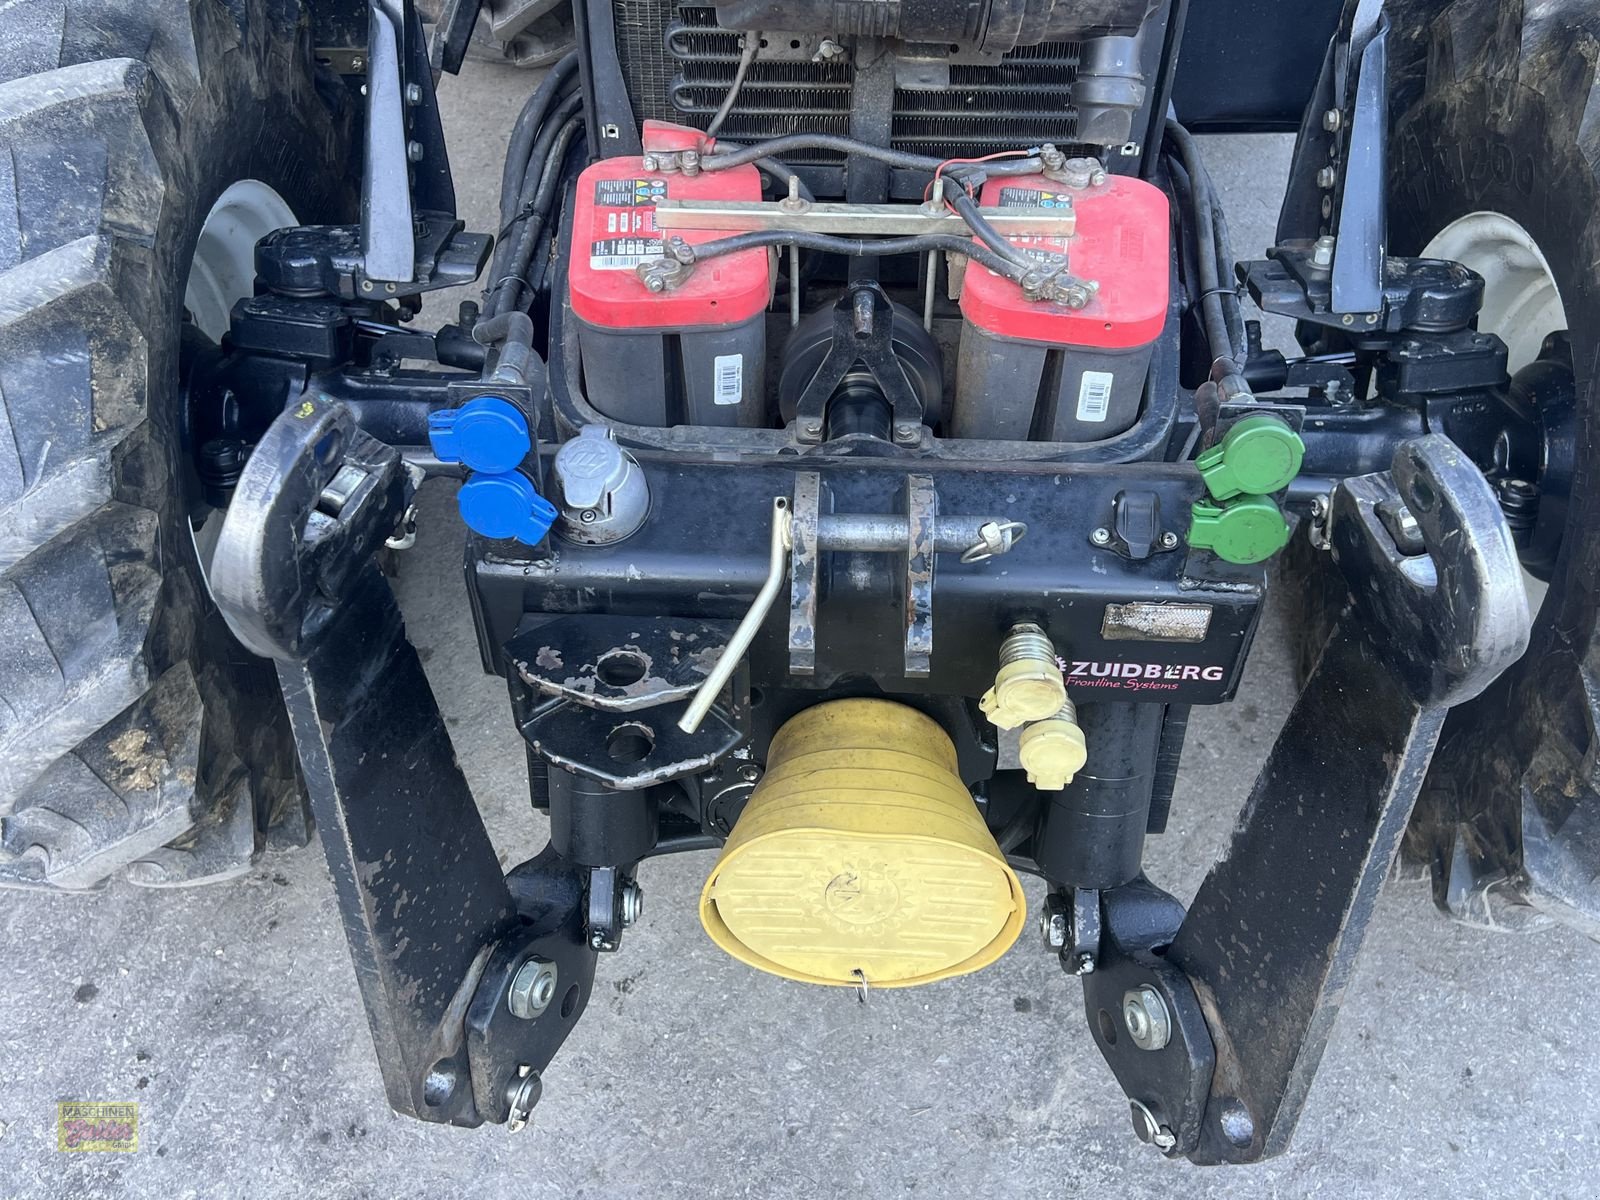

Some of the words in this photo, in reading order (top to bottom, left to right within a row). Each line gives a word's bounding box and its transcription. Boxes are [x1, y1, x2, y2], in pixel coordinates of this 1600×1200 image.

[1069, 661, 1223, 680] ZUIDBERG
[1065, 676, 1121, 688] Frontline
[1123, 678, 1179, 691] Systems
